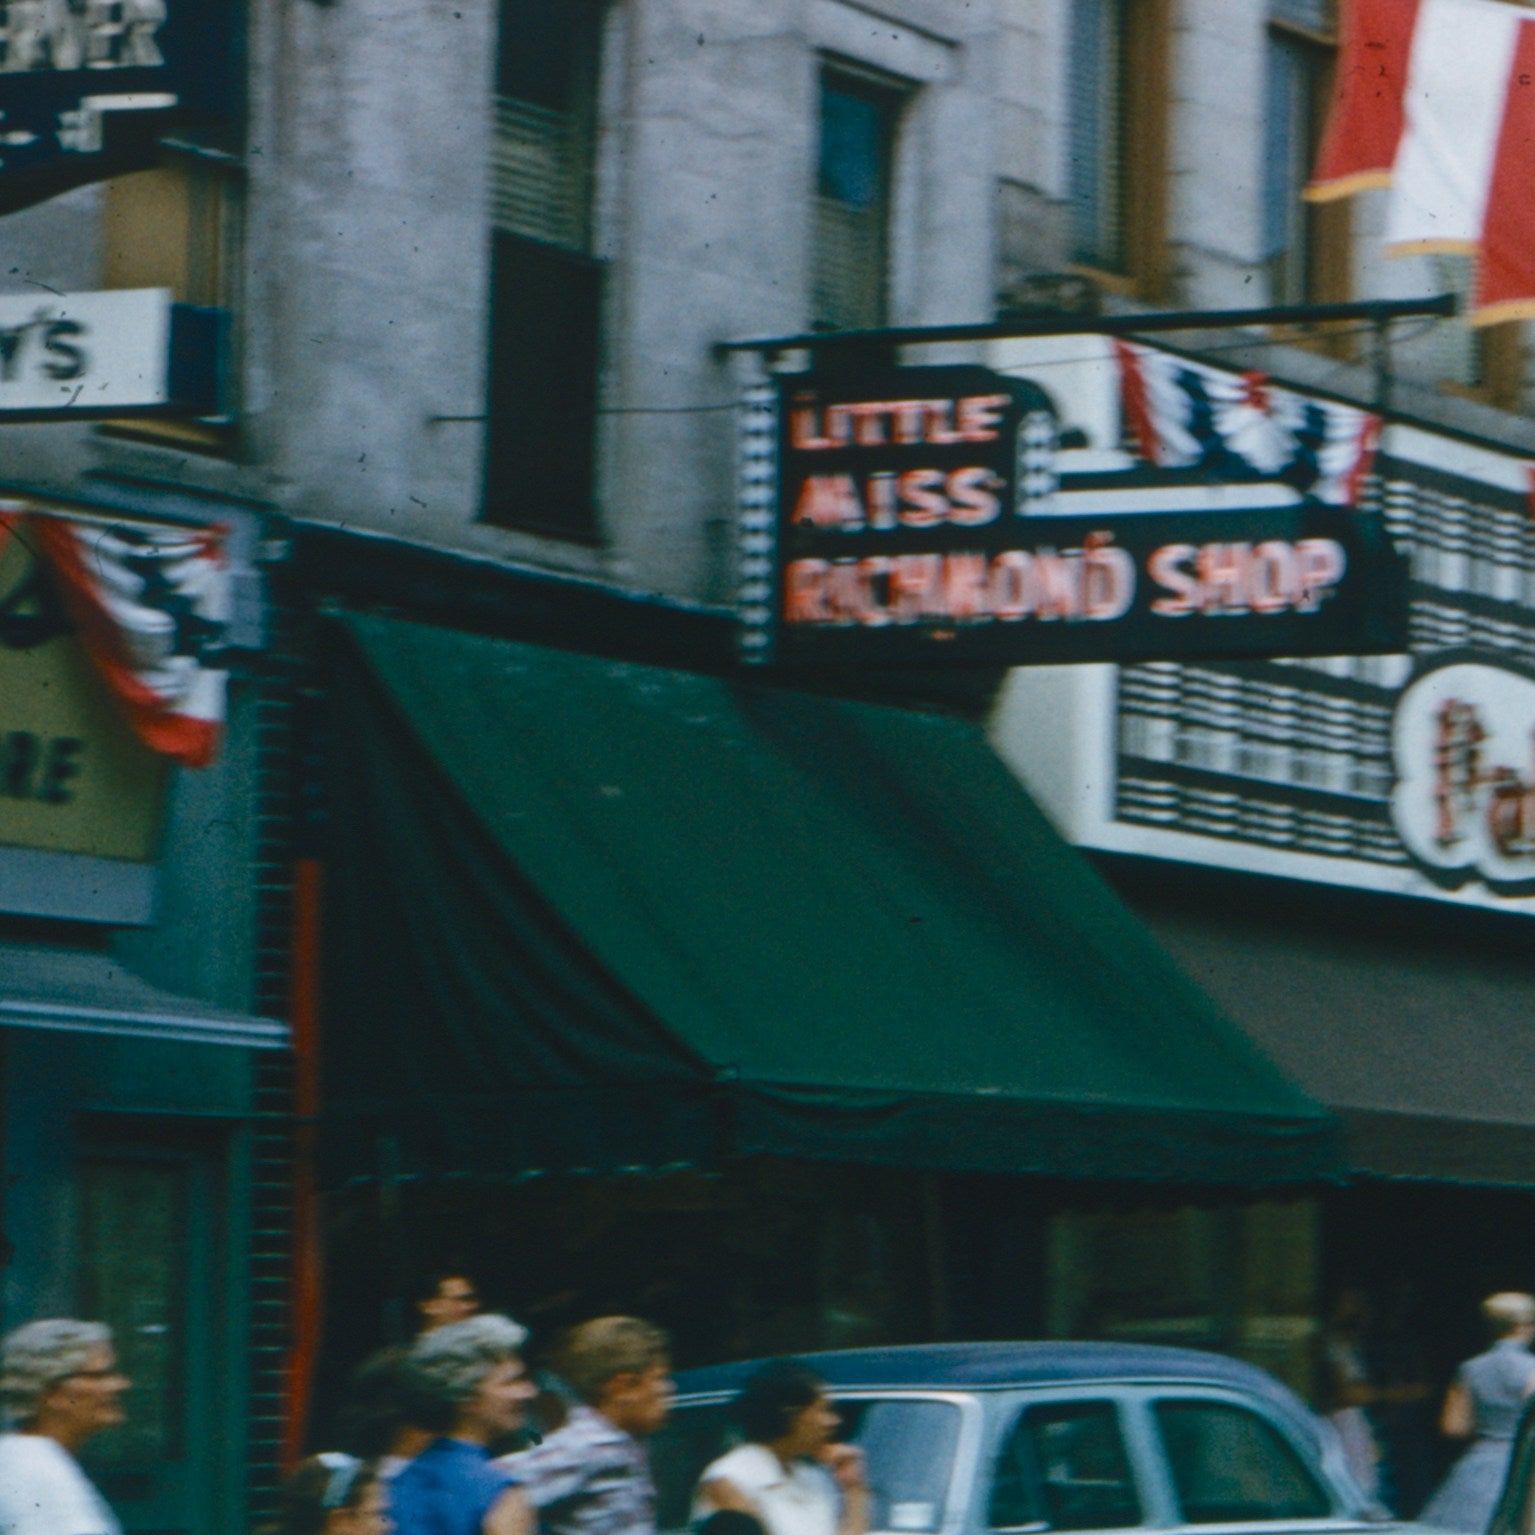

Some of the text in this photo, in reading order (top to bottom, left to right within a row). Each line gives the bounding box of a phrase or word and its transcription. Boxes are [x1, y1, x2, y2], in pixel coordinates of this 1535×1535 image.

[790, 392, 1008, 449] LITTLE
[792, 465, 1003, 533] MISS
[784, 536, 1347, 627] RICHMOND SHOP
